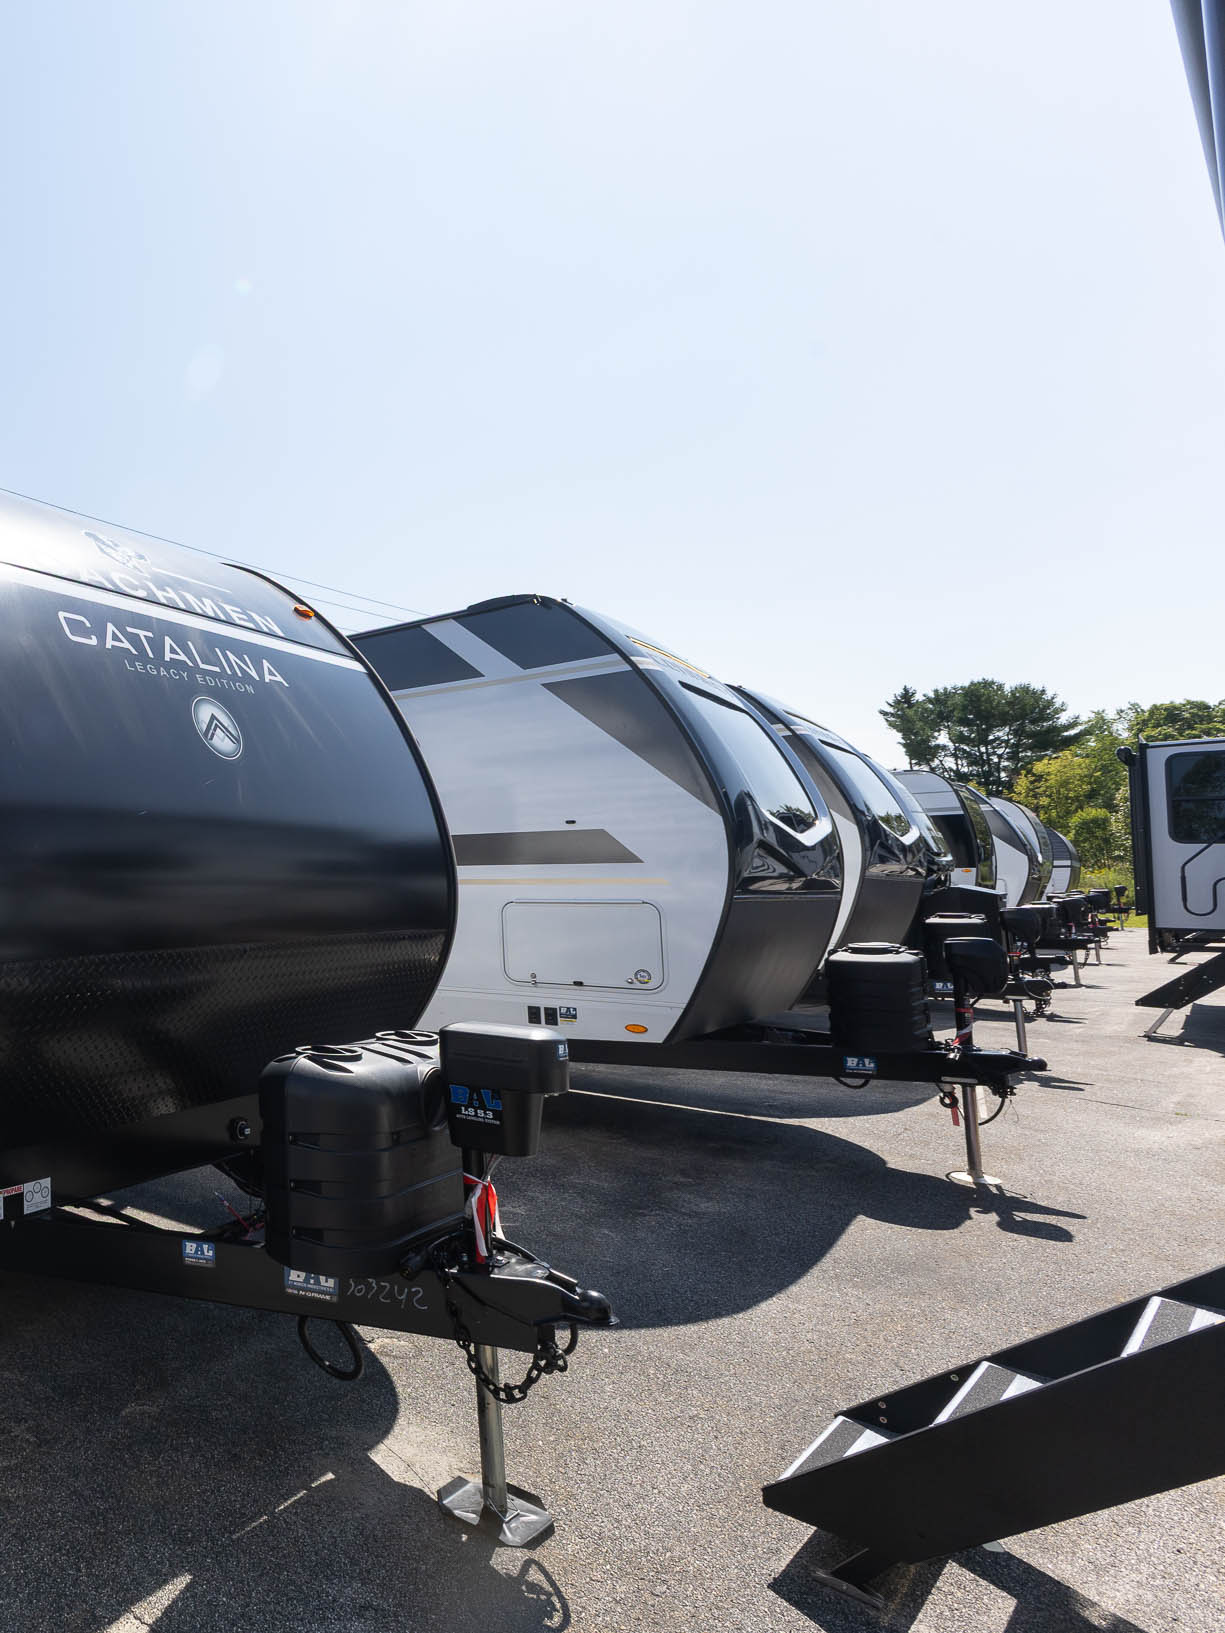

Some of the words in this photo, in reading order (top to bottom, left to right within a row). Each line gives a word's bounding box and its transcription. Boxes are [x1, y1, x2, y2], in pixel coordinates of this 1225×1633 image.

[57, 610, 289, 687] CATALINA
[124, 659, 188, 681] LEGACY
[196, 674, 256, 695] EDITION
[847, 1057, 874, 1067] BAL
[449, 1084, 503, 1111] BAL
[461, 1106, 476, 1116] LS
[185, 1242, 213, 1256] BAL
